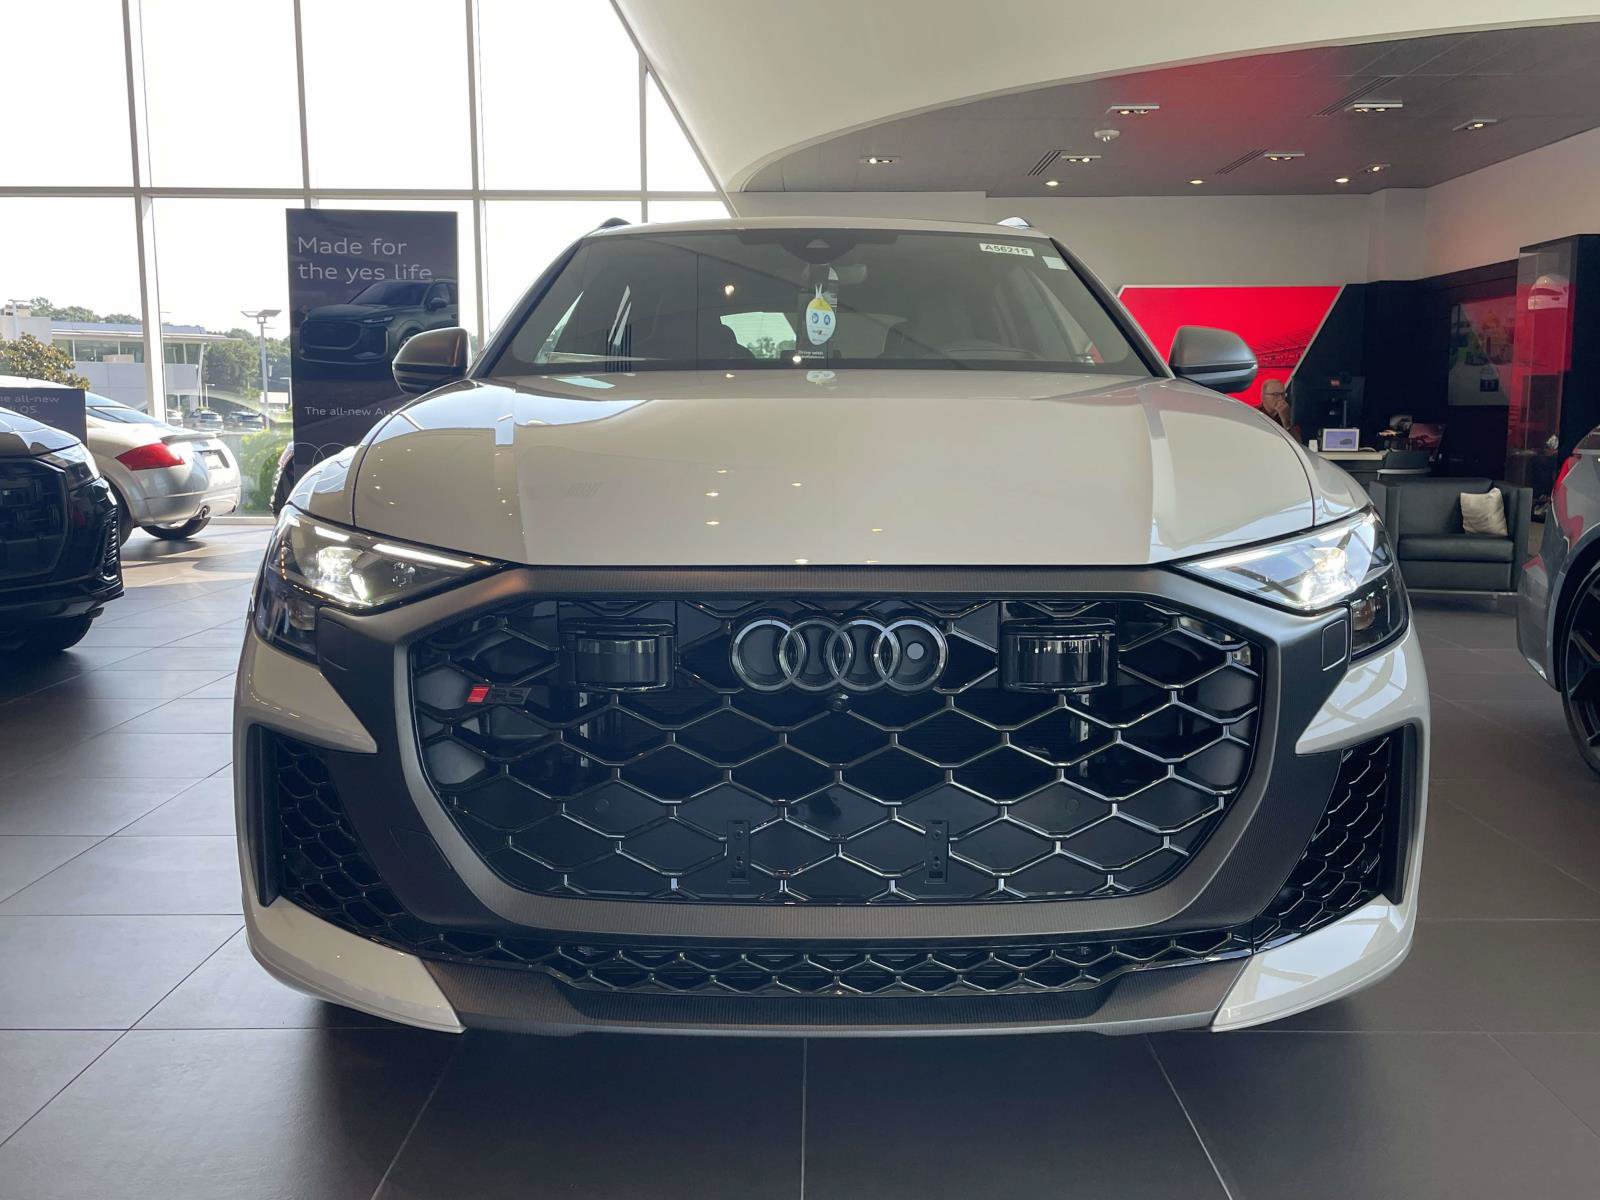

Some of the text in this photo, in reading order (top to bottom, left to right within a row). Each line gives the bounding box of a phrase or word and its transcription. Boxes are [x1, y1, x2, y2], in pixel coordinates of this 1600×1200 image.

[297, 236, 407, 255] Made for
[297, 262, 432, 284] the yes life
[15, 394, 60, 403] all-new
[304, 406, 327, 416] The
[329, 407, 371, 416] all-new
[491, 687, 523, 703] RS
